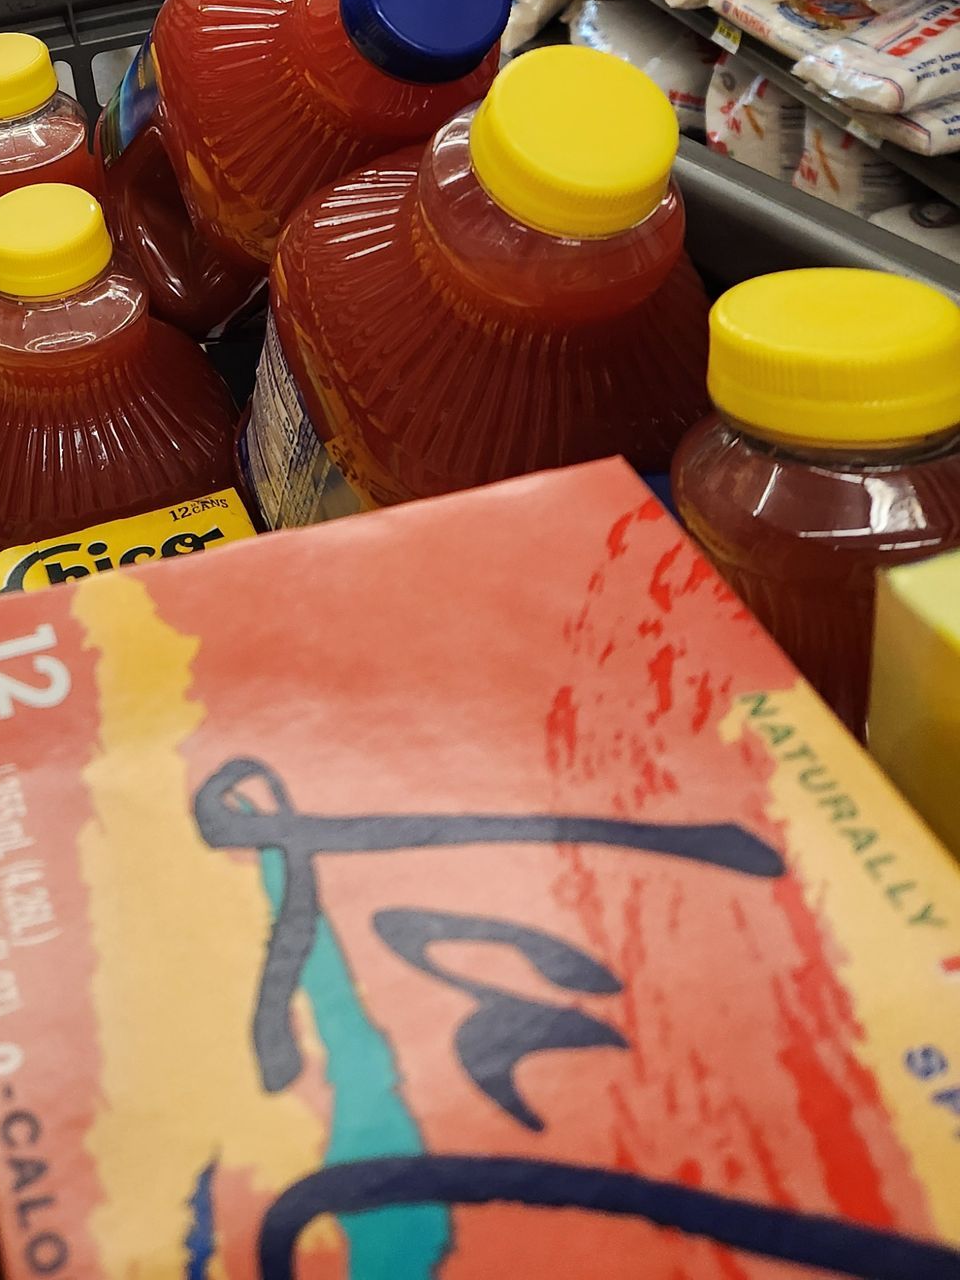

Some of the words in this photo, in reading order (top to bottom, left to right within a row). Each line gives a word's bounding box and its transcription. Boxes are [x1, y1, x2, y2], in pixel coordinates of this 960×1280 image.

[168, 506, 192, 522] 12
[192, 498, 229, 514] CANS
[742, 690, 947, 930] NATURALLY
[194, 755, 785, 1133] La
